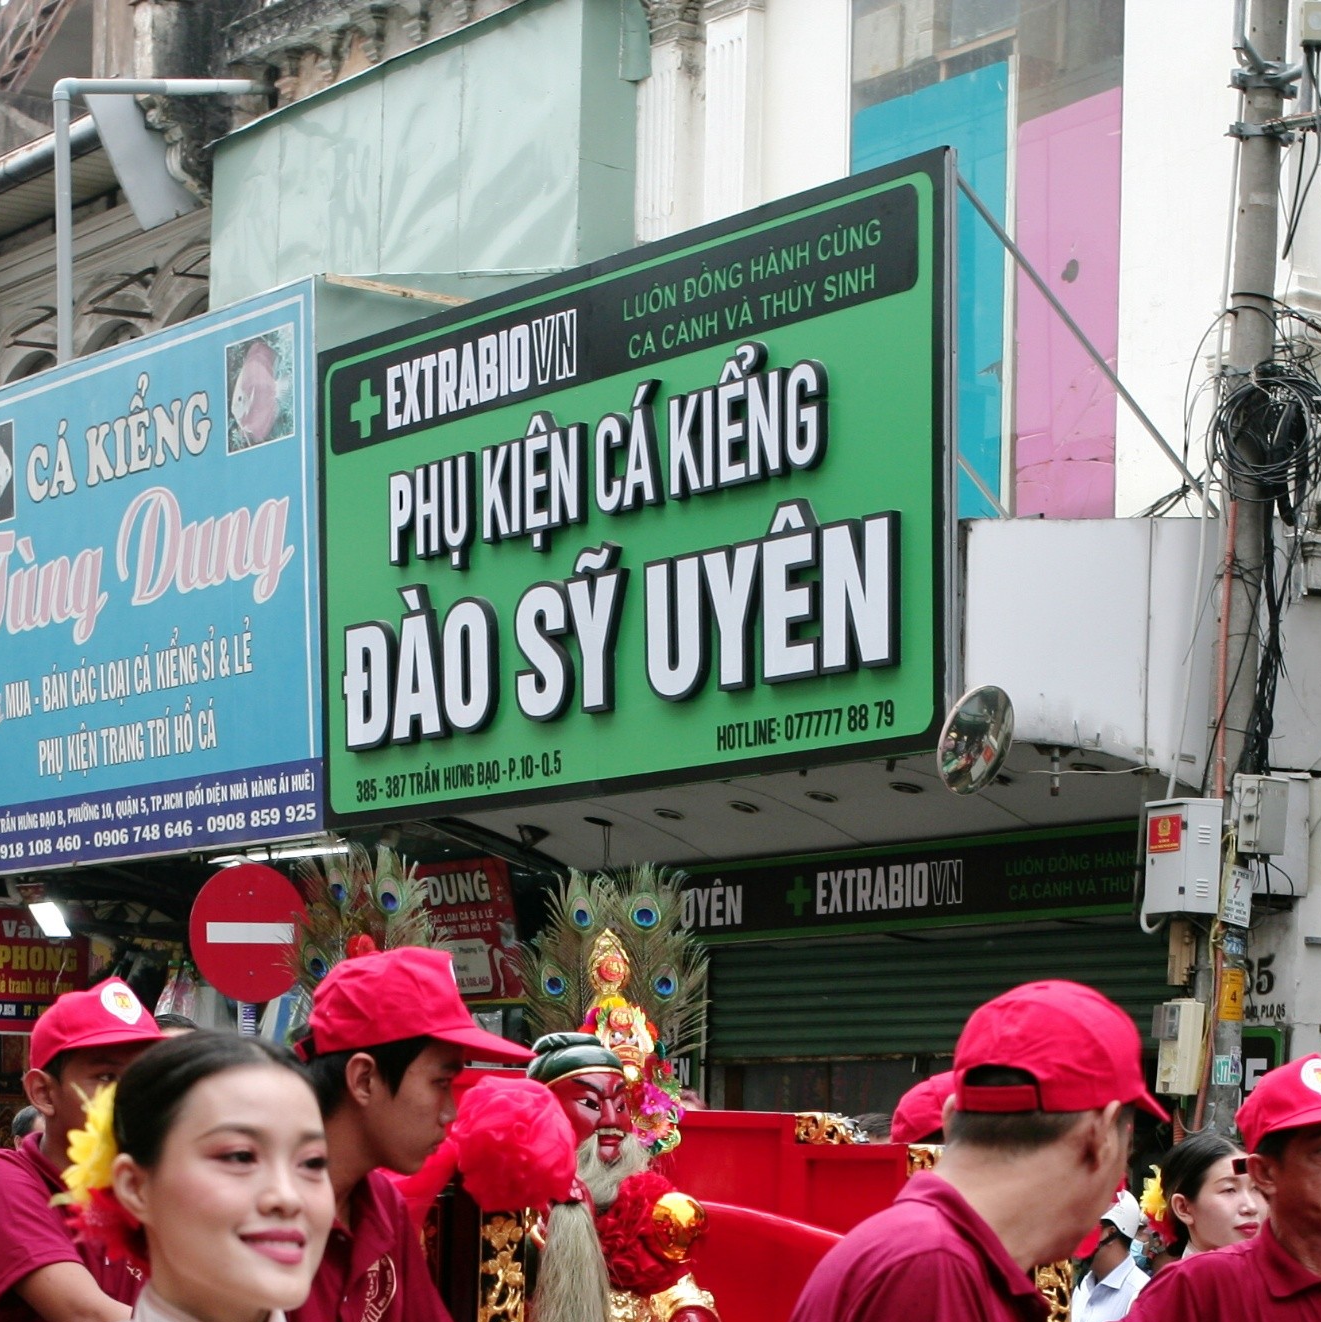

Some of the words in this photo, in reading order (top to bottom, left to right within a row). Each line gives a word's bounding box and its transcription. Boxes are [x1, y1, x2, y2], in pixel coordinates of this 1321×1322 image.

[623, 282, 676, 321] LUÔN
[683, 261, 743, 303] ĐỒNG
[750, 241, 810, 283] HÀNH
[817, 219, 881, 261] CÙNG
[824, 264, 875, 301] SINH
[386, 308, 578, 431] EXTRABIOVN
[26, 418, 77, 503] CÁ
[85, 371, 212, 488] KIỂNG
[389, 449, 474, 570] PHỤ
[482, 411, 586, 551] KIỆN
[595, 379, 662, 515] CÁ
[669, 341, 827, 500] KIỂNG
[116, 486, 294, 605] Dung
[343, 583, 499, 752] ĐÀO
[515, 541, 629, 718] SỸ
[643, 498, 901, 702] UYÊN
[5, 680, 32, 720] MUA
[42, 664, 68, 713] BÁN
[71, 658, 97, 707] CÁC
[100, 659, 131, 706] LOẠI
[133, 642, 152, 696] CÁ
[155, 626, 198, 690] KIỂNG
[201, 624, 215, 682] SỈ
[219, 636, 230, 678] &
[234, 615, 253, 675] LẺ
[38, 737, 63, 781] PHỤ
[68, 722, 98, 777] KIỆN
[100, 722, 145, 766] TRANG
[147, 707, 170, 758] TRÍ
[175, 696, 193, 754] HỒ
[197, 698, 217, 750] CÁ
[716, 722, 781, 751] HOTLINE:
[785, 706, 842, 743] 077777
[846, 704, 870, 733] 88
[874, 699, 895, 729] 79
[40, 814, 56, 831] ĐẠO
[67, 802, 99, 824] PHƯỜNG
[101, 803, 114, 821] 10,
[115, 795, 139, 820] QUẬN
[140, 798, 149, 816] 5,
[150, 792, 183, 812] TP.HCM
[185, 782, 205, 809] (ĐỐI
[206, 782, 228, 806] DIỆN
[229, 778, 249, 800] NHÀ
[251, 776, 277, 798] HÀNG
[279, 773, 289, 794] ÁI
[409, 762, 440, 796] TRẦN
[444, 763, 474, 790] HƯNG
[477, 760, 500, 790] ĐẠO
[542, 750, 562, 776] Q.5
[28, 838, 52, 856] 108
[55, 835, 81, 853] 460
[94, 829, 129, 848] 0906
[133, 824, 160, 843] 748
[164, 820, 193, 839] 646
[206, 812, 246, 833] 0908
[250, 808, 281, 827] 859
[285, 803, 316, 823] 925
[428, 869, 491, 906] DUNG
[816, 858, 964, 916] EXTRABIOVN
[8, 977, 32, 994] tranh
[1230, 990, 1237, 1003] 4
